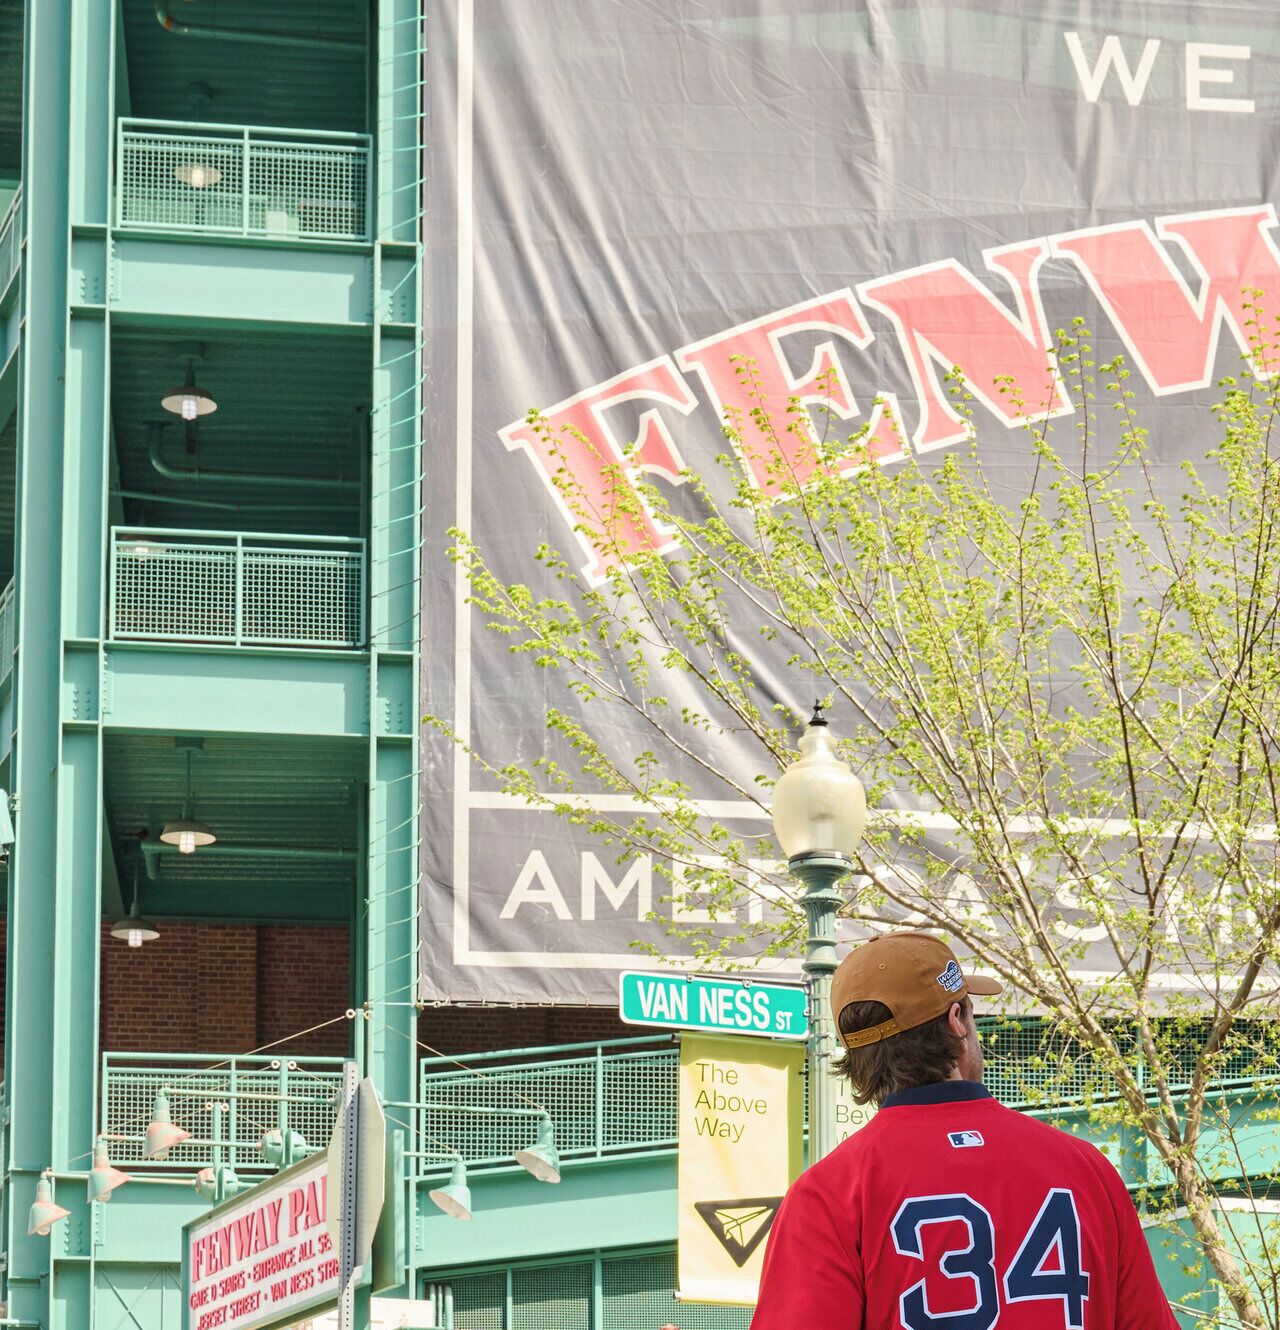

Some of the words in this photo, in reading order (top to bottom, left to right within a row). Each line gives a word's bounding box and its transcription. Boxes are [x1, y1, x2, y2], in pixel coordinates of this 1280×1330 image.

[499, 849, 1114, 944] AMERCA'S
[636, 980, 689, 1021] VAN
[700, 986, 771, 1030] NESS
[775, 1011, 793, 1031] ST
[696, 1062, 738, 1085] The
[695, 1090, 767, 1115] Above
[695, 1117, 745, 1143] Way
[192, 1198, 283, 1283] FENWAY
[289, 1174, 328, 1238] PA
[219, 1270, 246, 1298] STAIRS
[253, 1246, 297, 1283] ENTRANCE
[299, 1239, 316, 1263] ALL
[230, 1290, 261, 1320] STREET
[270, 1278, 288, 1302] VAN
[290, 1268, 315, 1295] NESS
